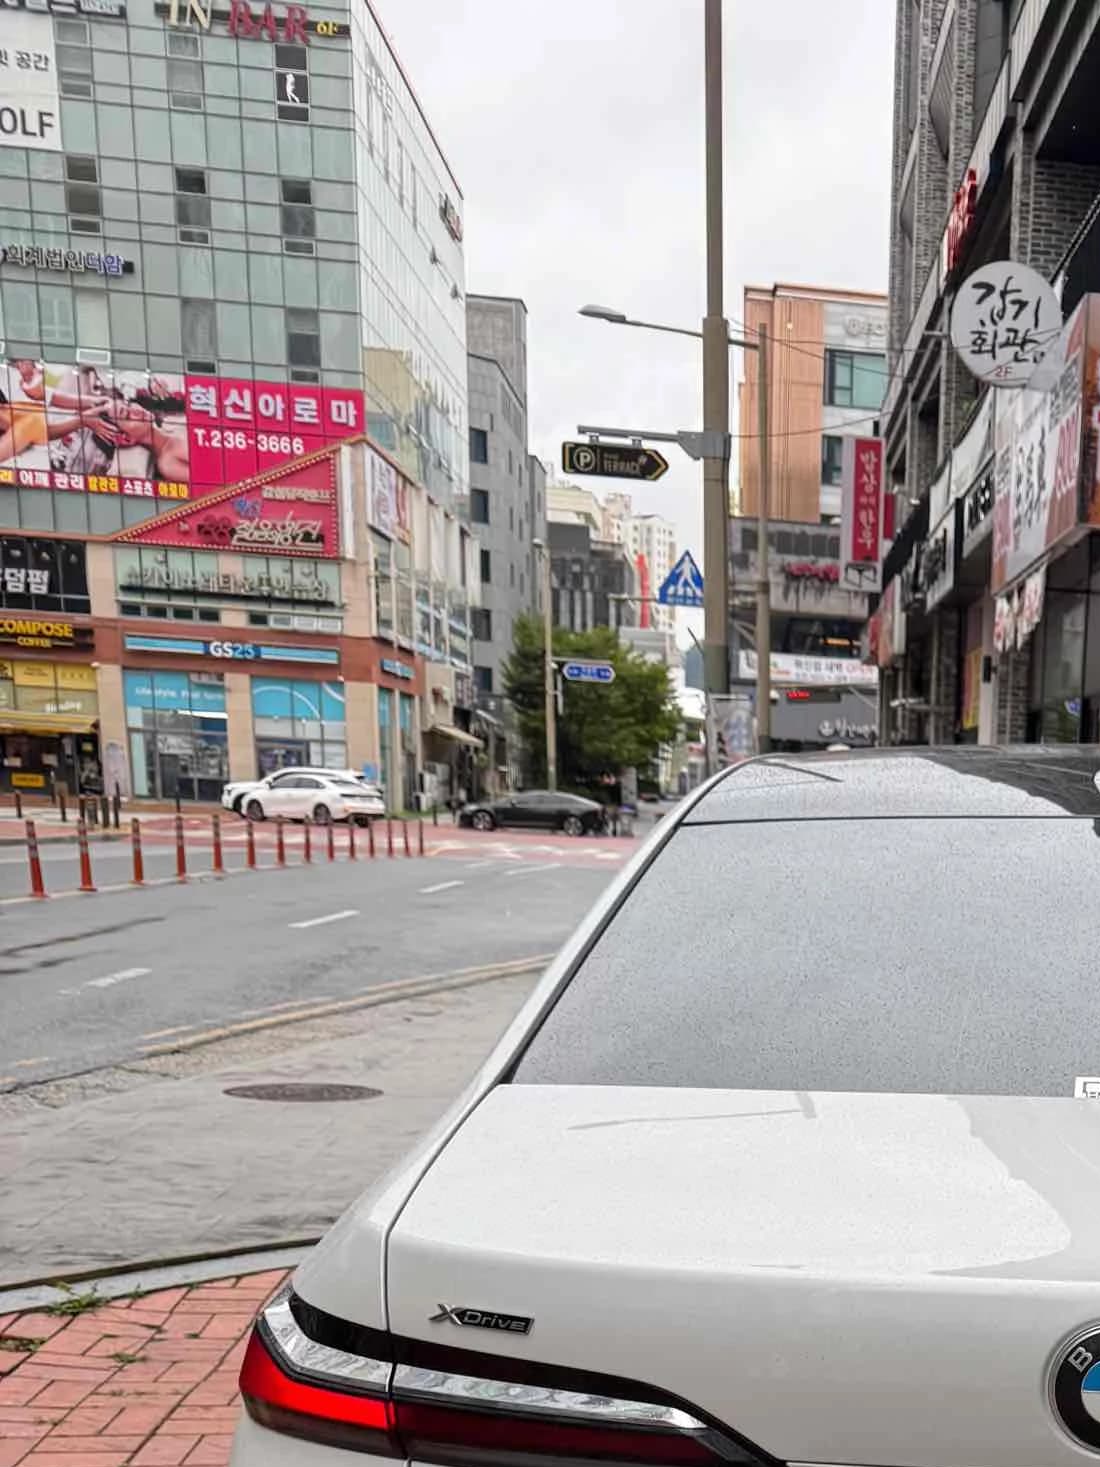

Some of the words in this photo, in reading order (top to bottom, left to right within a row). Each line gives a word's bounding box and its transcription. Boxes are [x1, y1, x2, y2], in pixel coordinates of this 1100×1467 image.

[227, 0, 311, 46] BAR
[969, 319, 1041, 363] 회관
[188, 383, 358, 428] 혁신아로마
[194, 427, 304, 455] T.236-3666
[209, 641, 256, 659] GS25
